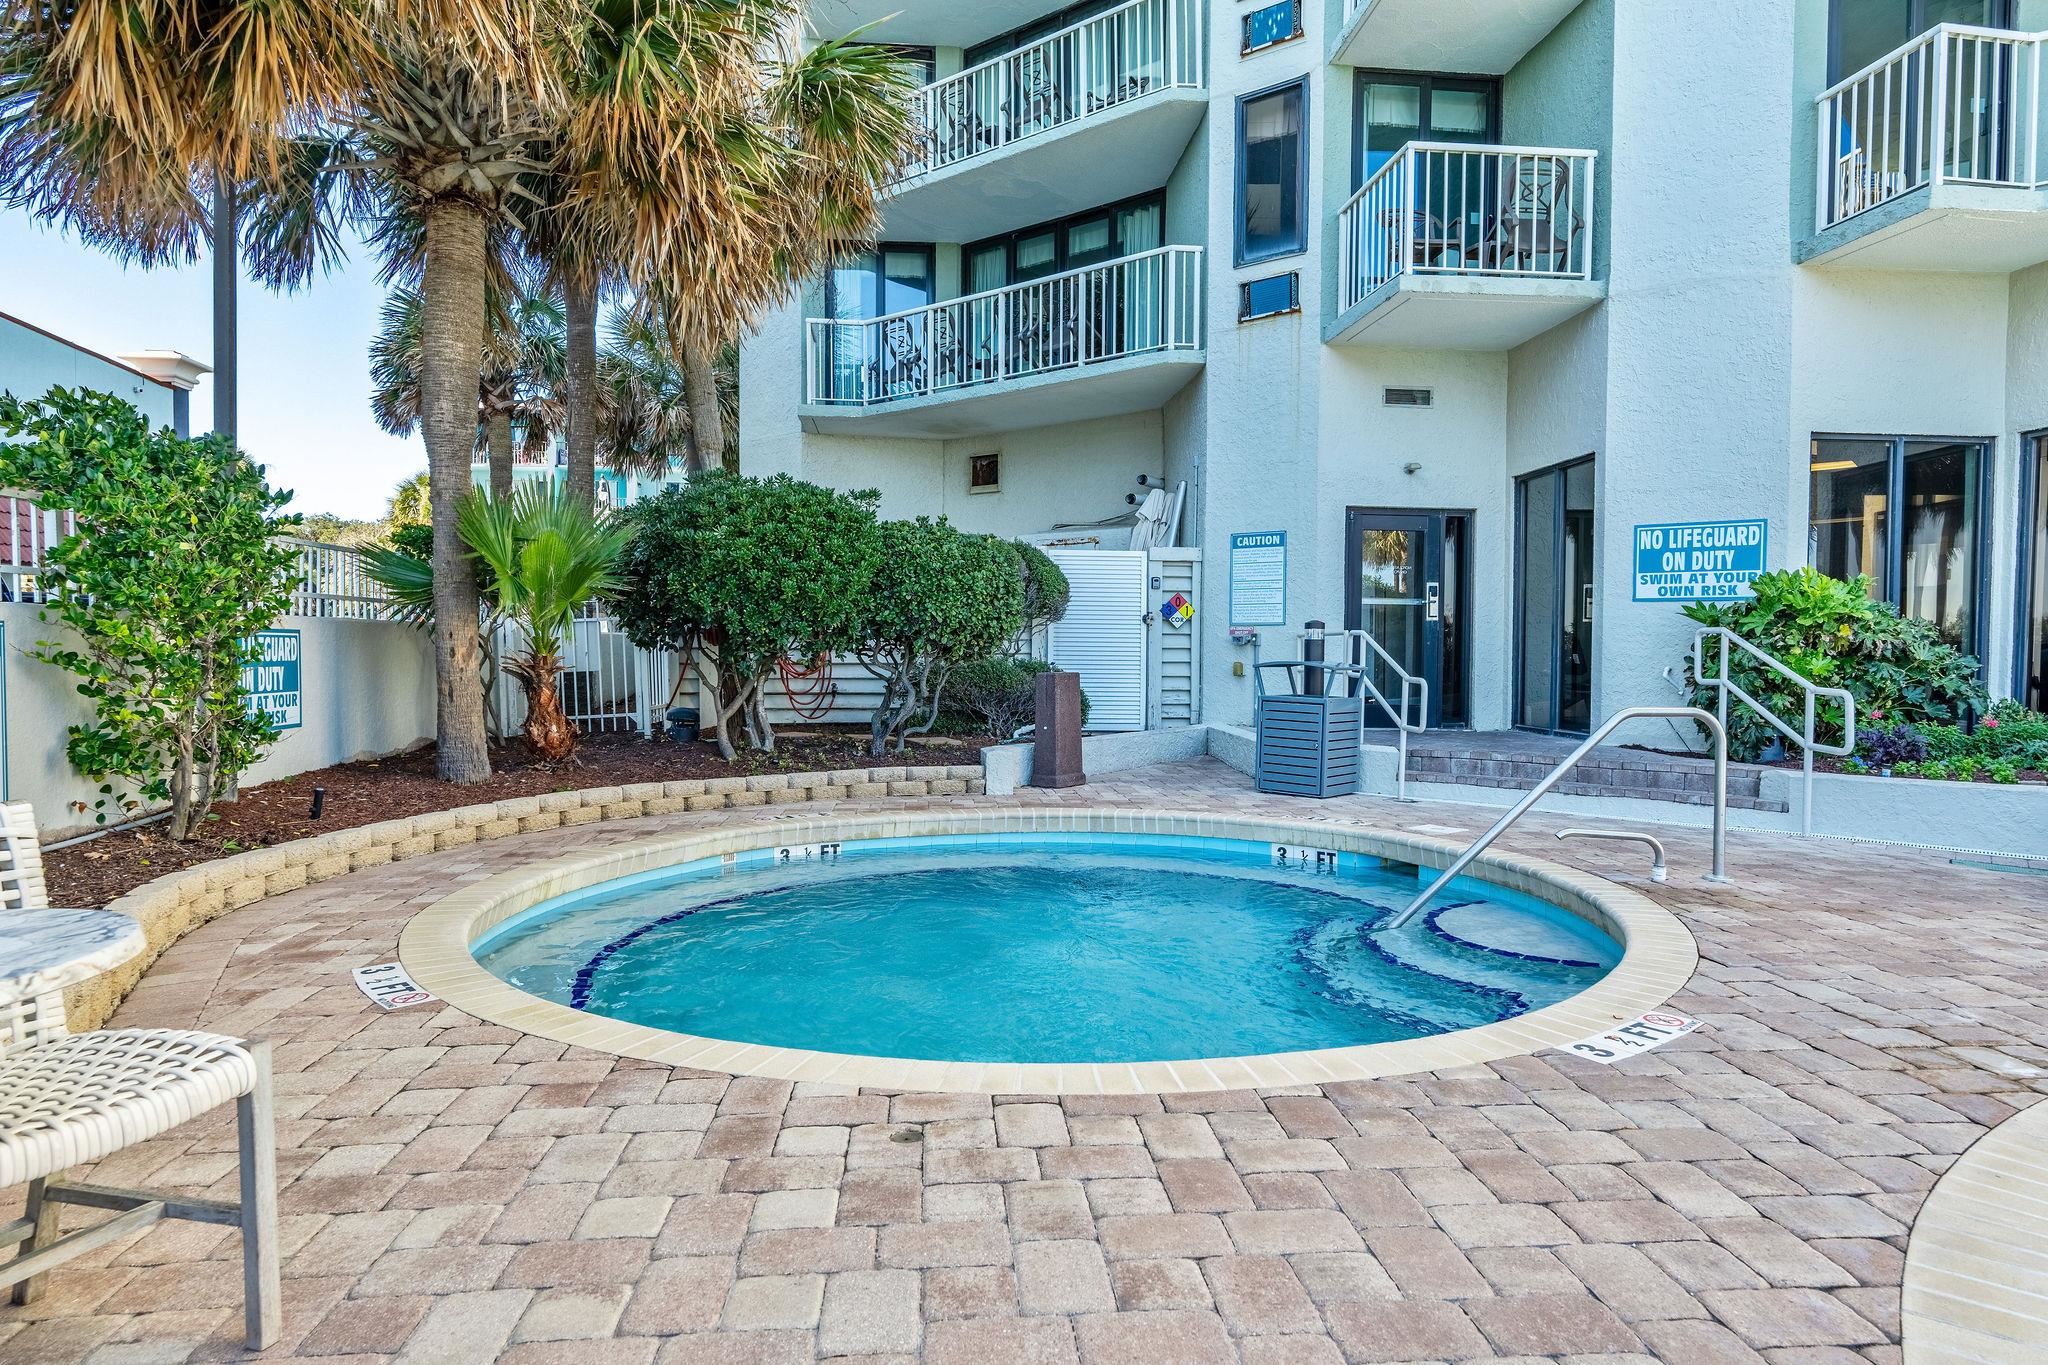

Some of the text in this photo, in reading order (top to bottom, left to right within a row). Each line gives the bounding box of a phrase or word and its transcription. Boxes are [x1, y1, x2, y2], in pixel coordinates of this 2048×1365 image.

[1236, 535, 1280, 547] CAUTION
[1640, 526, 1760, 549] NO LIFEGUARD
[1662, 549, 1735, 571] ON DUTY
[1640, 571, 1759, 585] SWIM AT YOUR
[1657, 584, 1738, 597] OWN RISK
[1175, 596, 1181, 607] 0
[1165, 604, 1172, 616] 3
[1185, 605, 1189, 616] 1
[257, 666, 284, 692] DUTY
[257, 695, 269, 709] AT
[272, 693, 298, 708] YOUR
[780, 848, 790, 859] 3
[820, 843, 840, 857] FT
[1277, 847, 1287, 859] 3
[1316, 851, 1337, 864] FT
[360, 966, 396, 975] 3
[370, 981, 417, 996] FT
[1573, 1043, 1615, 1057] 3
[1617, 1022, 1673, 1041] FT
